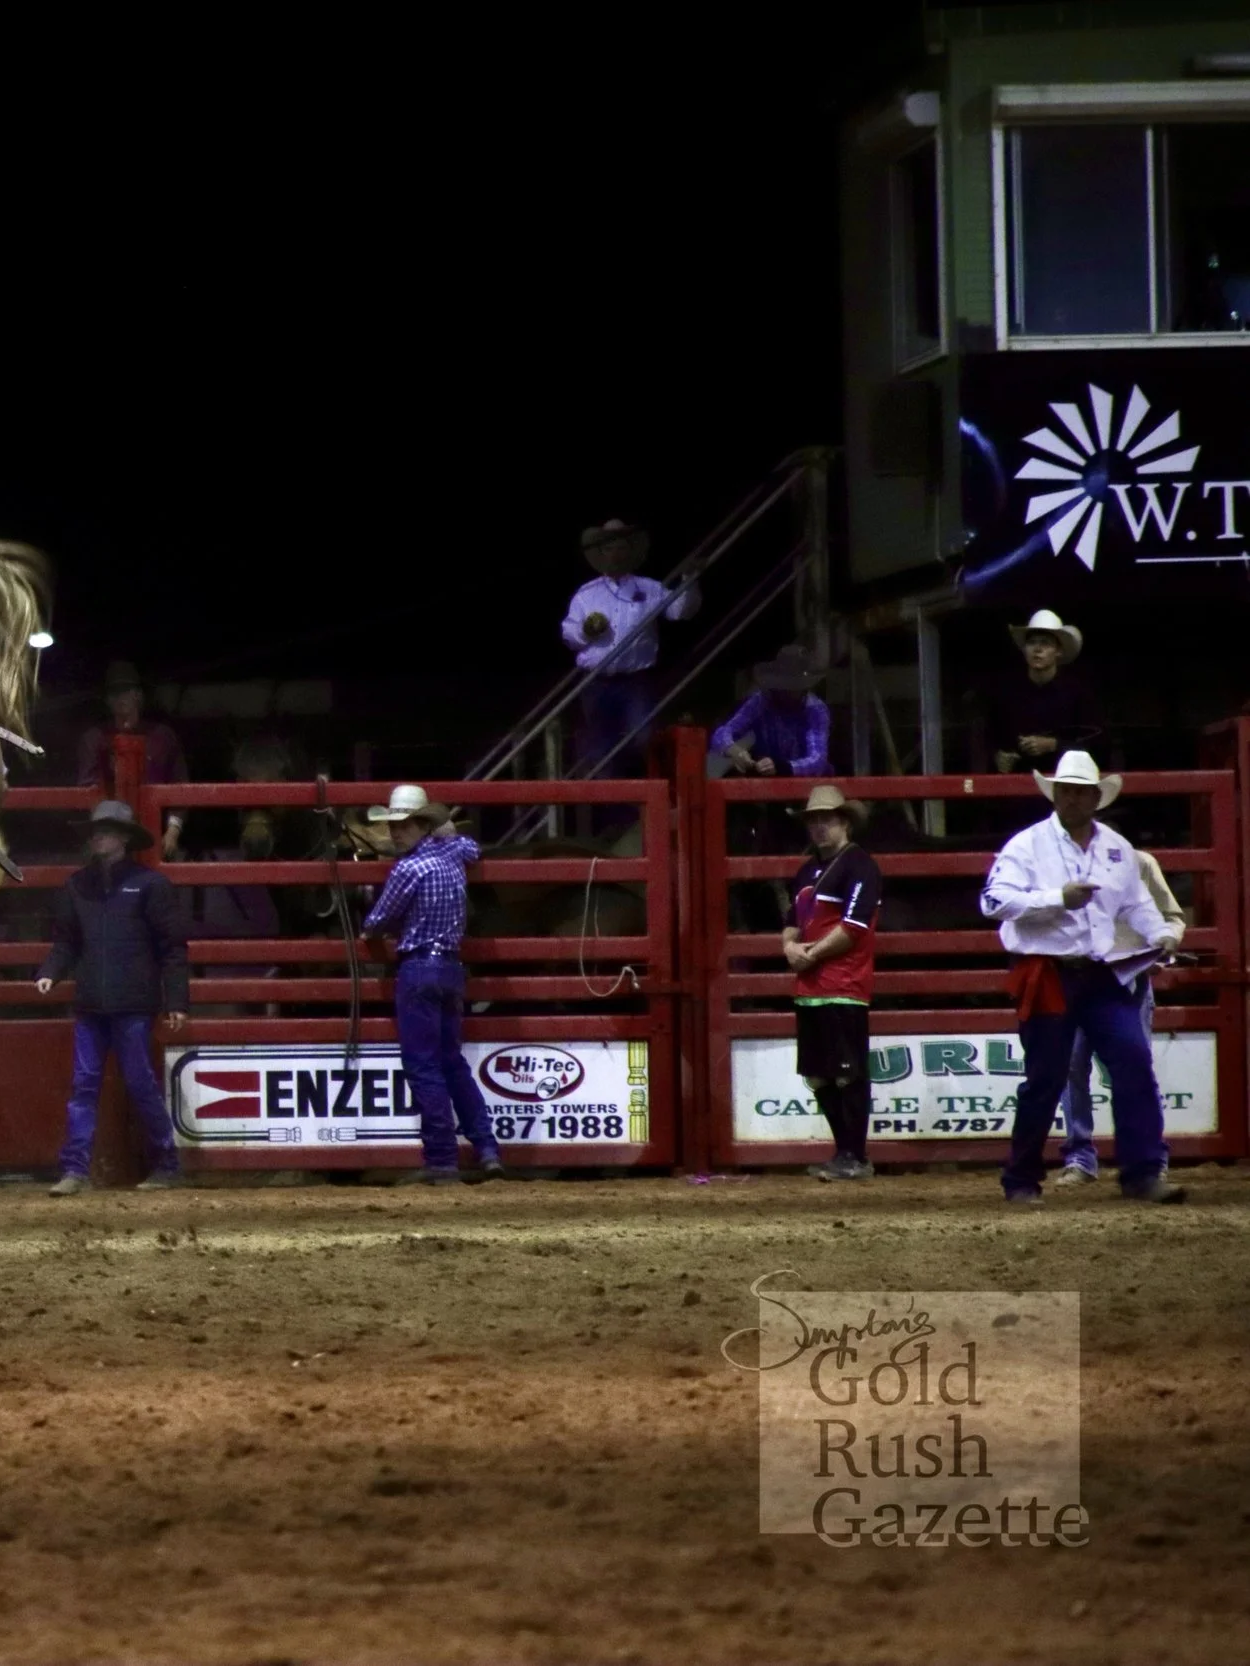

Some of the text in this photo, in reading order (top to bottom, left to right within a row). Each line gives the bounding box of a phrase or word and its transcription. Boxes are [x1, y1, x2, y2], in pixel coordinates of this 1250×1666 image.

[514, 1056, 576, 1073] Hi-Tec
[485, 1103, 618, 1115] ARTERS TOWERS
[754, 1097, 920, 1116] CALE
[491, 1114, 624, 1141] 87 1988
[872, 1117, 1006, 1133] PH. 4787
